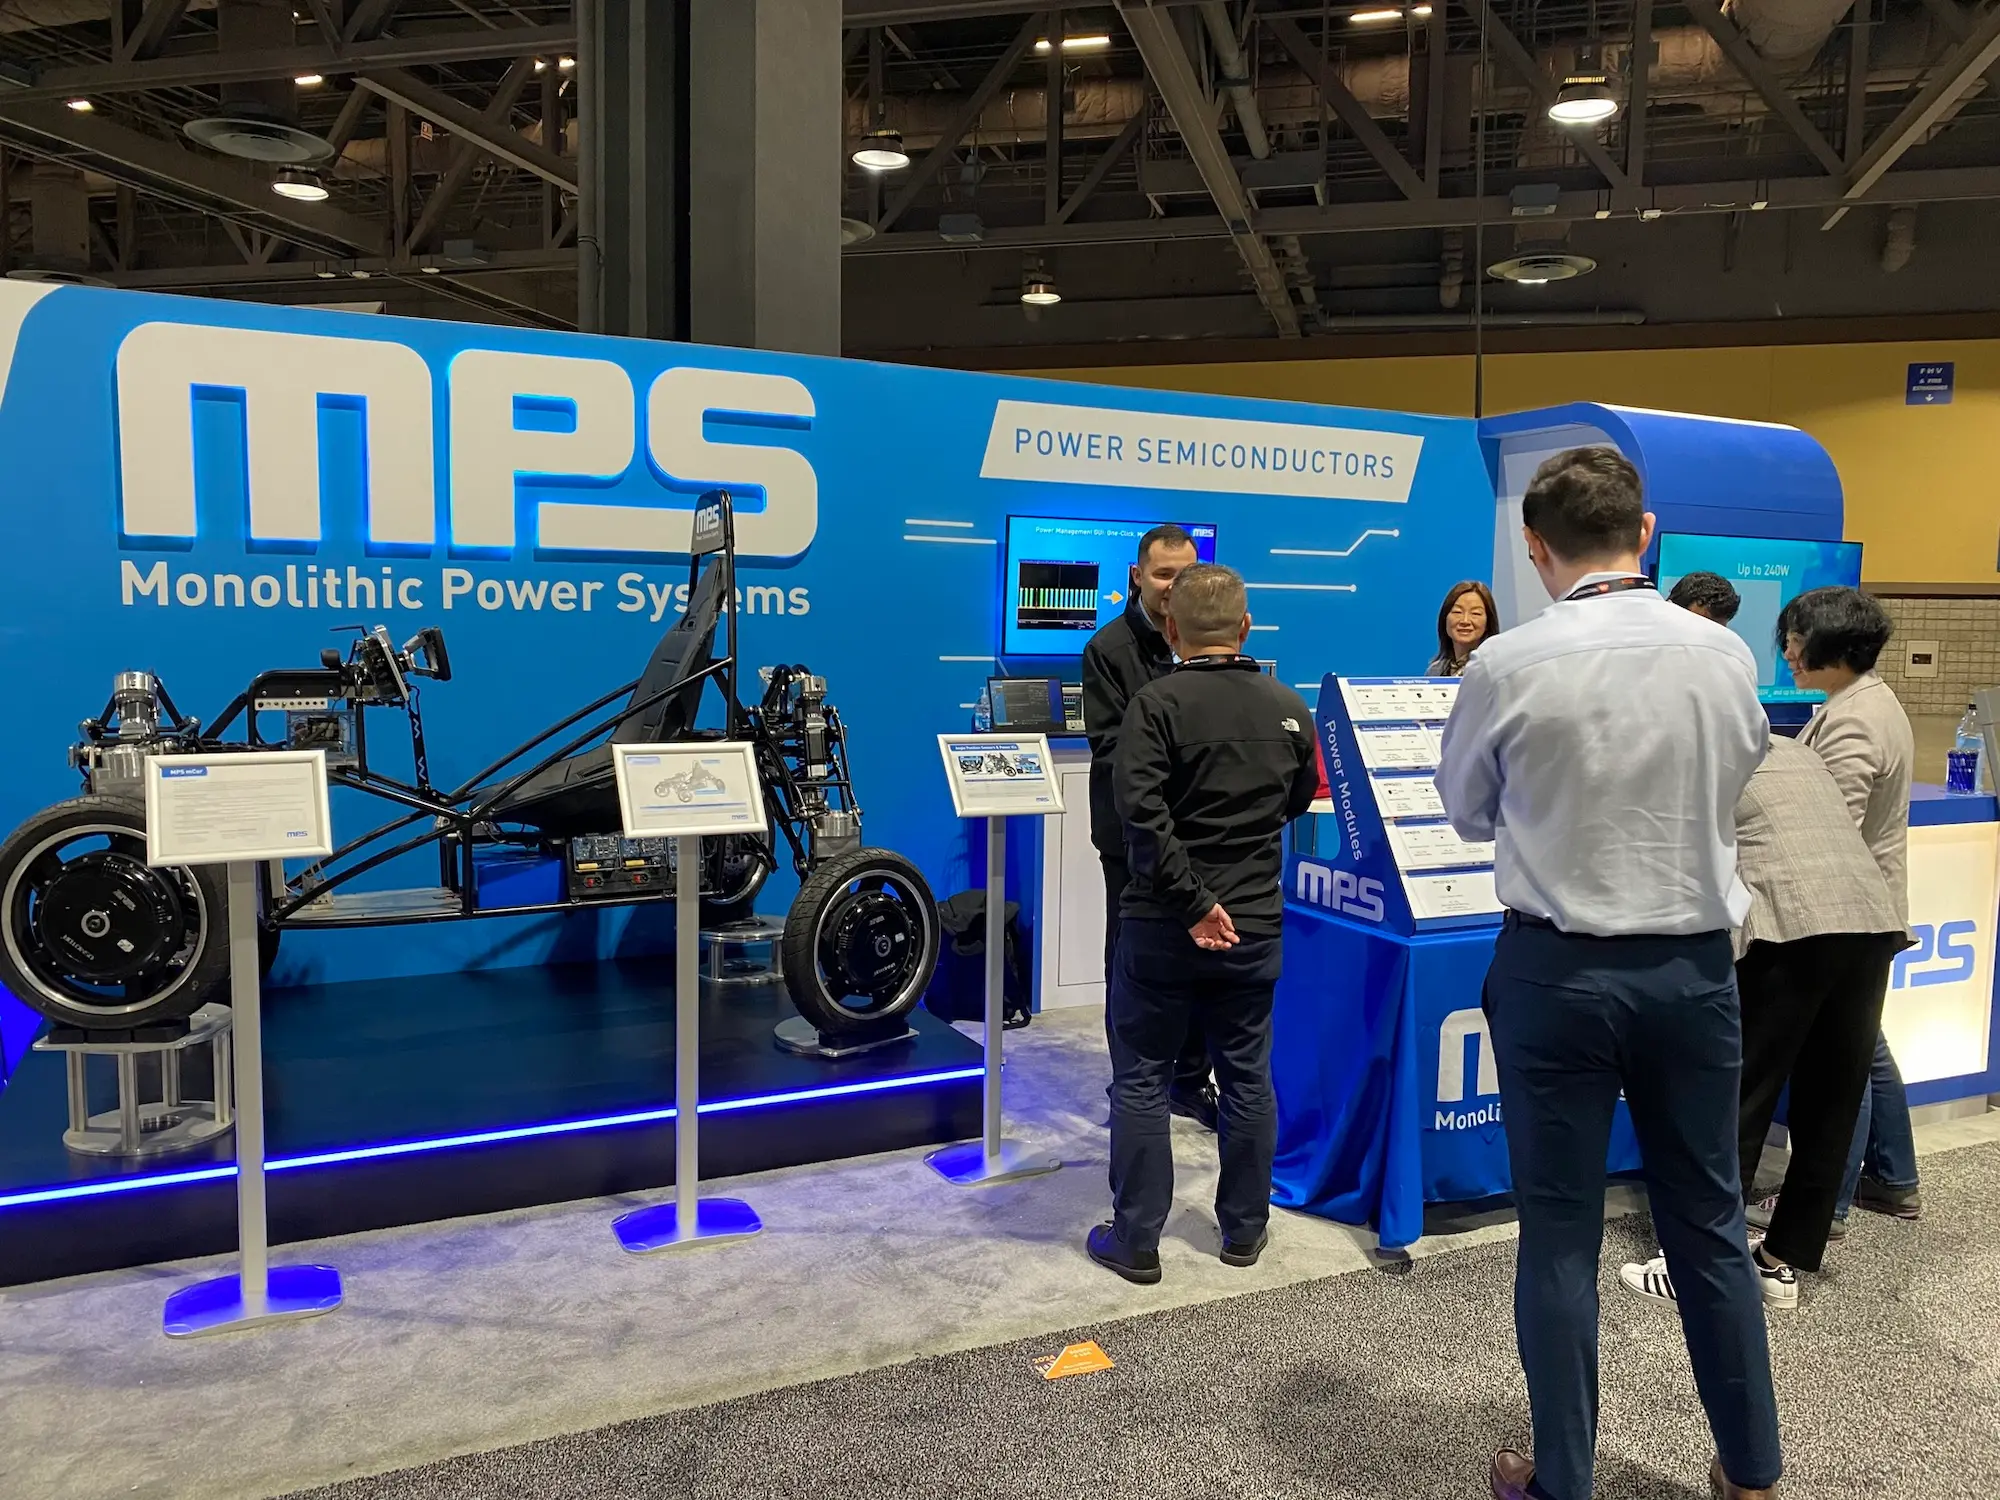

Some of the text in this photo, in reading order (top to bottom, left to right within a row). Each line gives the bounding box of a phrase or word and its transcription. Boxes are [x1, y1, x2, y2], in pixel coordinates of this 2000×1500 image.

[117, 321, 818, 557] MPS
[1016, 428, 1394, 479] POWER SEMICONDUCTORS
[696, 503, 720, 534] MPS
[1035, 526, 1054, 534] Power
[1056, 527, 1092, 536] Management
[1193, 528, 1214, 537] MPS
[1737, 562, 1790, 578] Up to 240W
[120, 560, 810, 623] Monolithic Power Sysms
[1325, 720, 1363, 861] Power Modules
[286, 830, 308, 838] MPS
[1297, 861, 1385, 923] MPS
[1891, 919, 1977, 990] PS
[1434, 1102, 1501, 1131] Monoli
